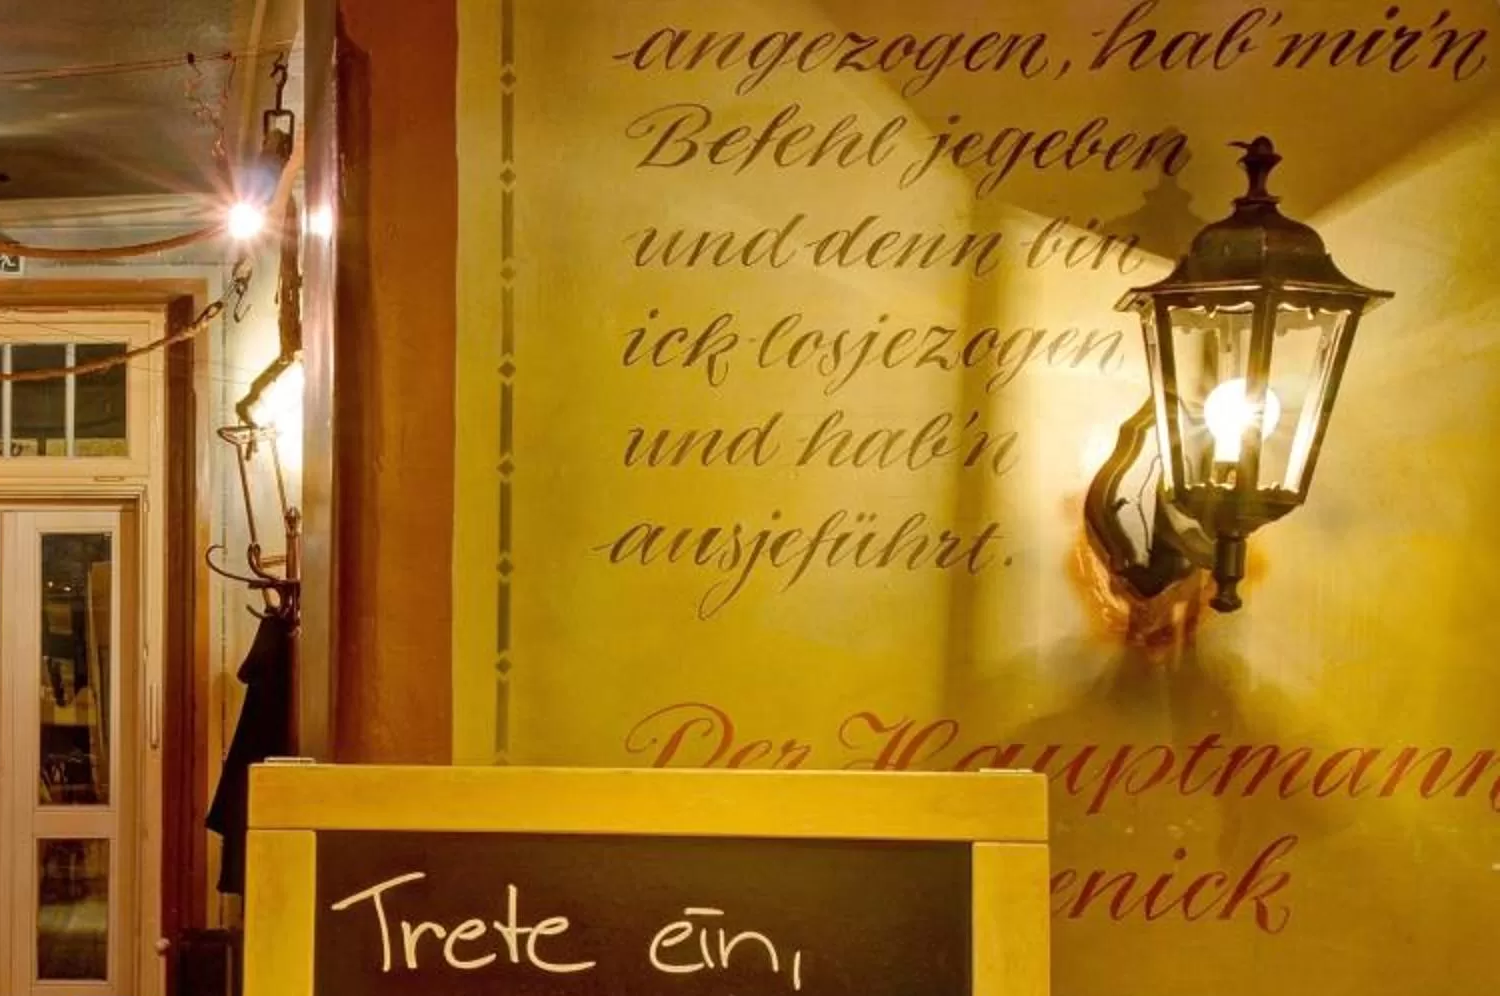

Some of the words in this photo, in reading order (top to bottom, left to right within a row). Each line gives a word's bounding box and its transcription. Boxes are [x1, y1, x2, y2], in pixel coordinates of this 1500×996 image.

[612, 25, 1071, 98] angezogen,
[624, 103, 907, 175] Befehl
[900, 112, 1192, 199] jegeben
[623, 213, 806, 269] und
[804, 214, 1003, 277] denn
[1021, 214, 1145, 276] bin
[620, 307, 741, 388] ick
[757, 312, 1126, 397] losjezogen
[623, 411, 784, 468] und
[592, 508, 1014, 622] ausjeführt.
[1050, 834, 1298, 934] enick
[331, 872, 597, 973] Trete
[649, 907, 802, 990] ein,
